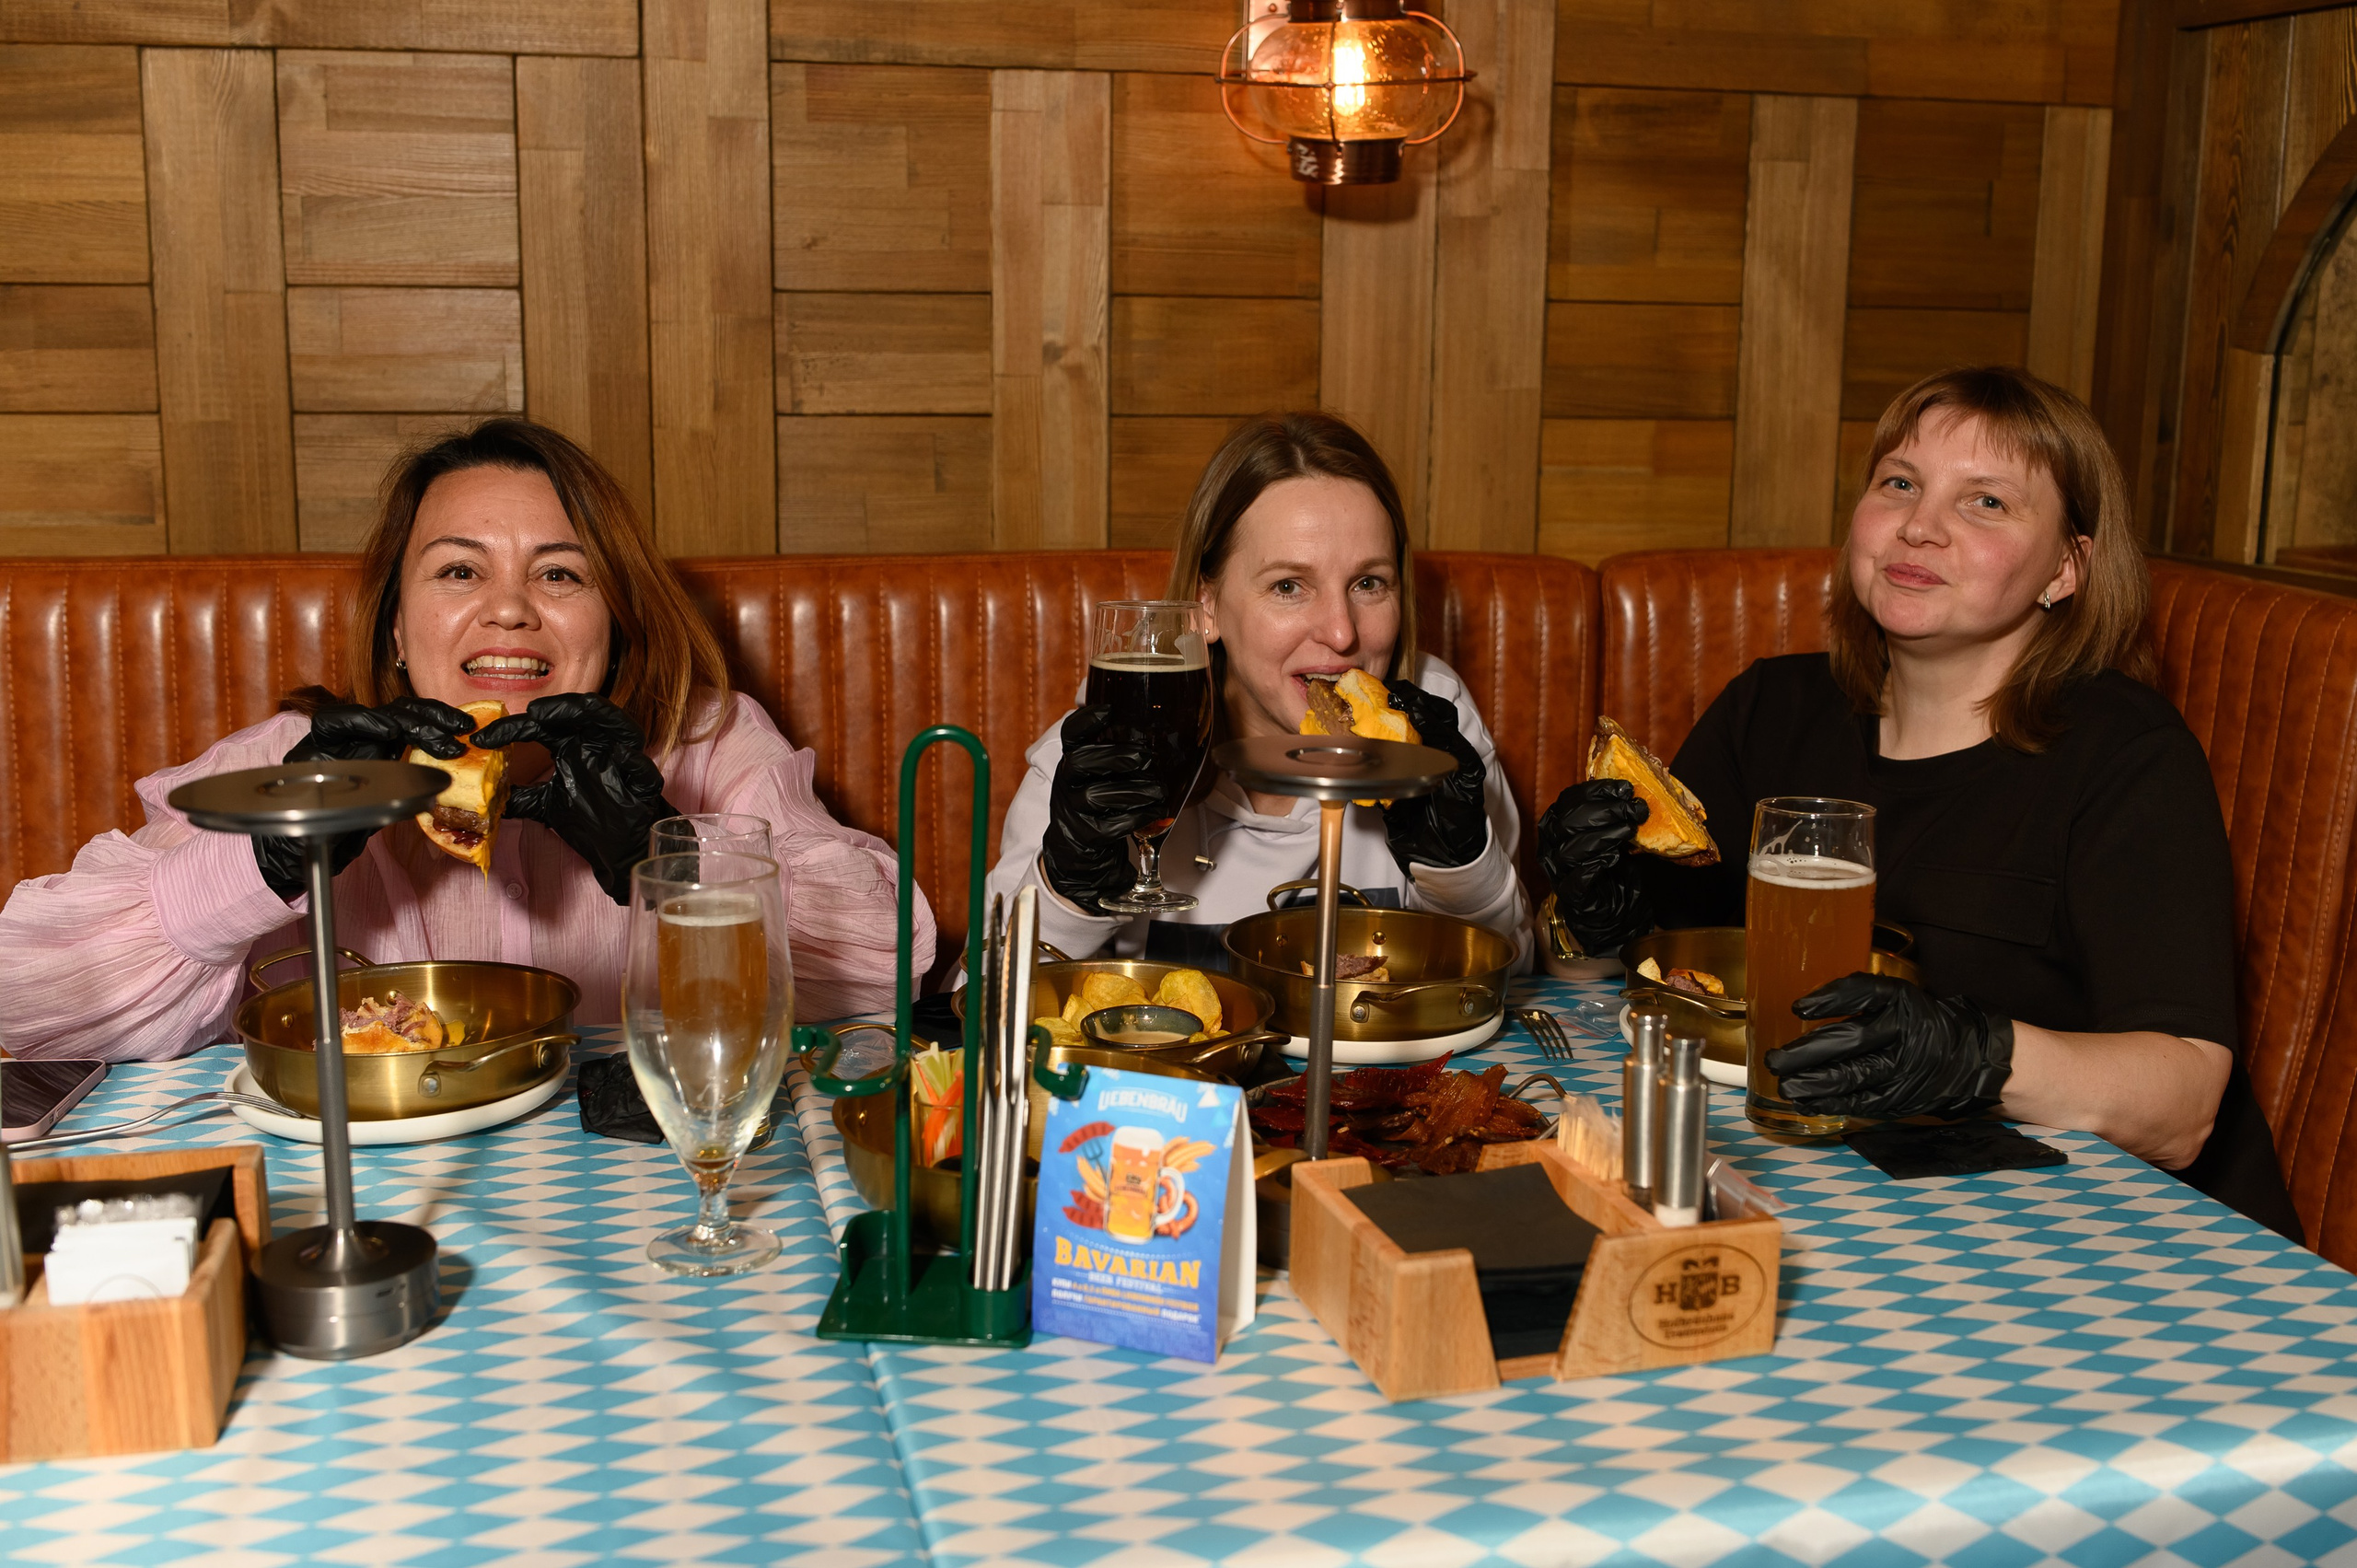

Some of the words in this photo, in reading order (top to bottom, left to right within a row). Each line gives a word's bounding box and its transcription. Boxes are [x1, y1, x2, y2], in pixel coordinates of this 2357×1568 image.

[1054, 1236, 1202, 1288] BAVARIAN
[1654, 1283, 1677, 1305] H
[1721, 1275, 1740, 1296] B
